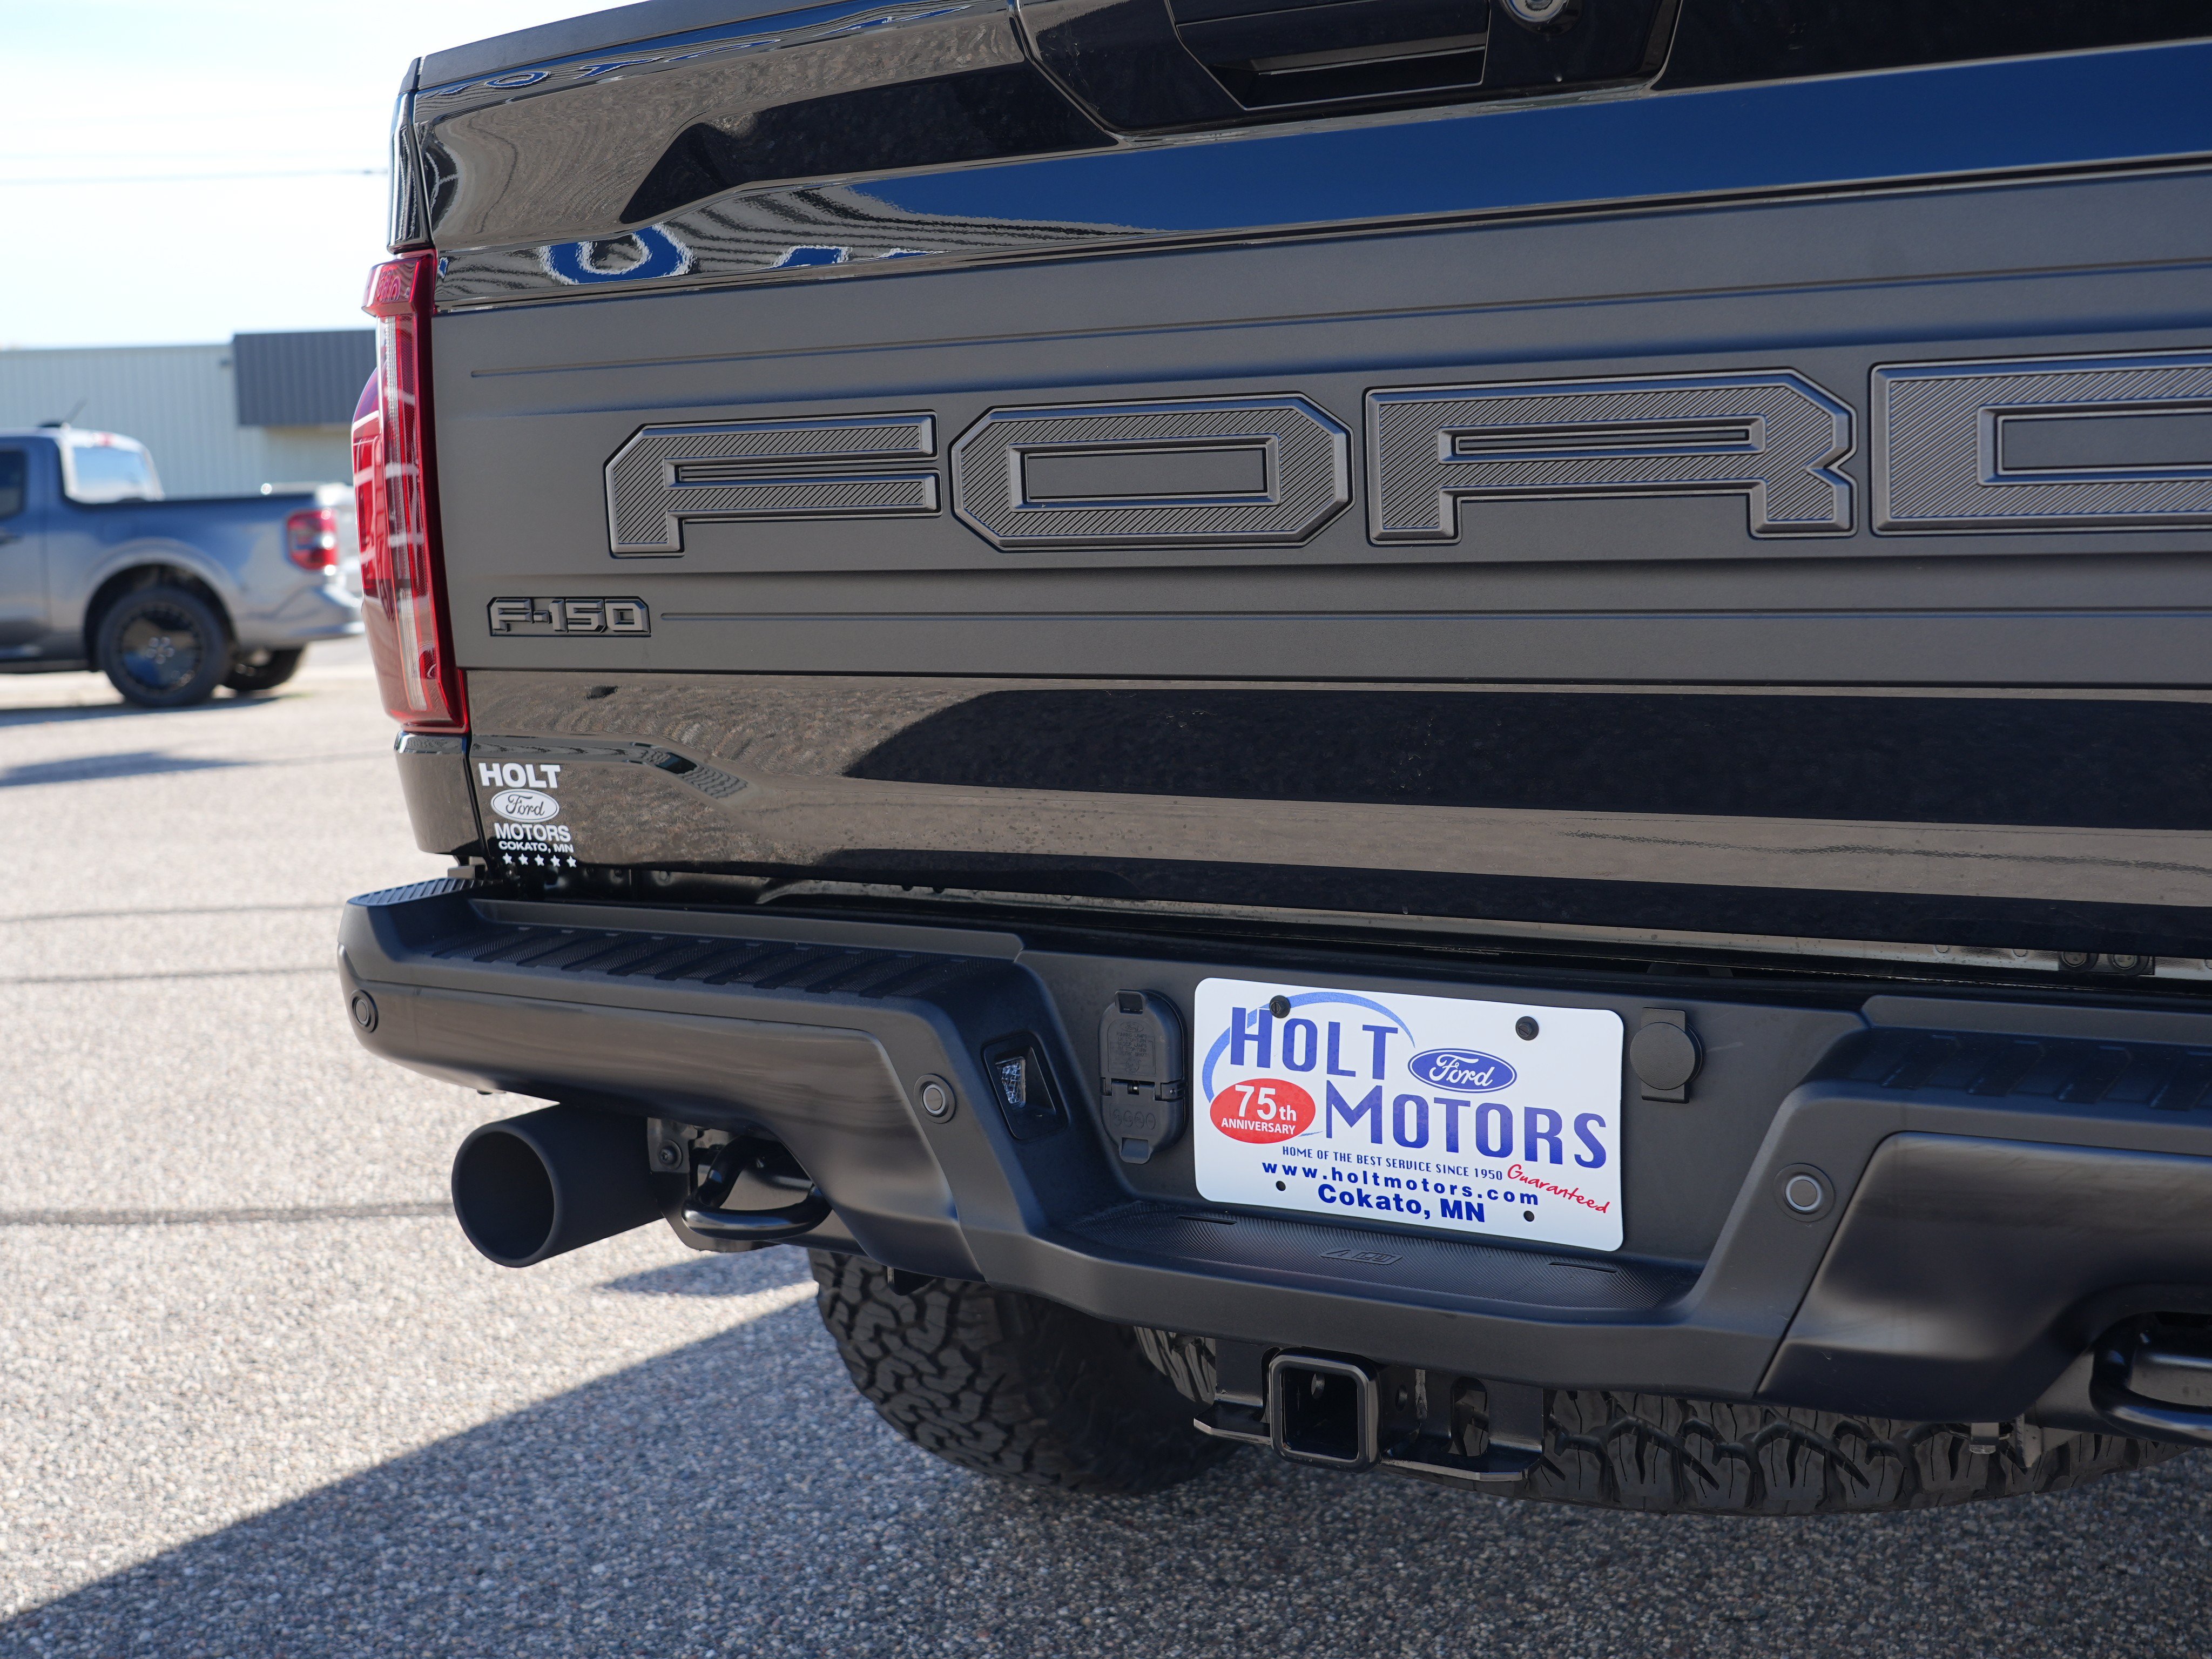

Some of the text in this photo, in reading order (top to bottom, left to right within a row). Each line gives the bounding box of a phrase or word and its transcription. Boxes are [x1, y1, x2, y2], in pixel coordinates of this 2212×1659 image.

[605, 349, 2212, 558] FORD
[489, 597, 651, 635] F-150
[478, 763, 561, 788] HOLT
[494, 822, 571, 848] MOTORS
[498, 841, 574, 853] COKATO, MN
[1230, 1007, 1398, 1080] HOLT
[1235, 1084, 1297, 1122] 75th
[1221, 1118, 1296, 1135] ANNIVERSARY
[1326, 1080, 1607, 1169] MOTORS
[1283, 1146, 1502, 1180] HOME OF THE BEST SERVICE SINCE 1950
[1262, 1162, 1538, 1205] www.holtmotors.com
[1507, 1164, 1610, 1213] Guaranteed
[1318, 1184, 1485, 1223] Cokato, MN
